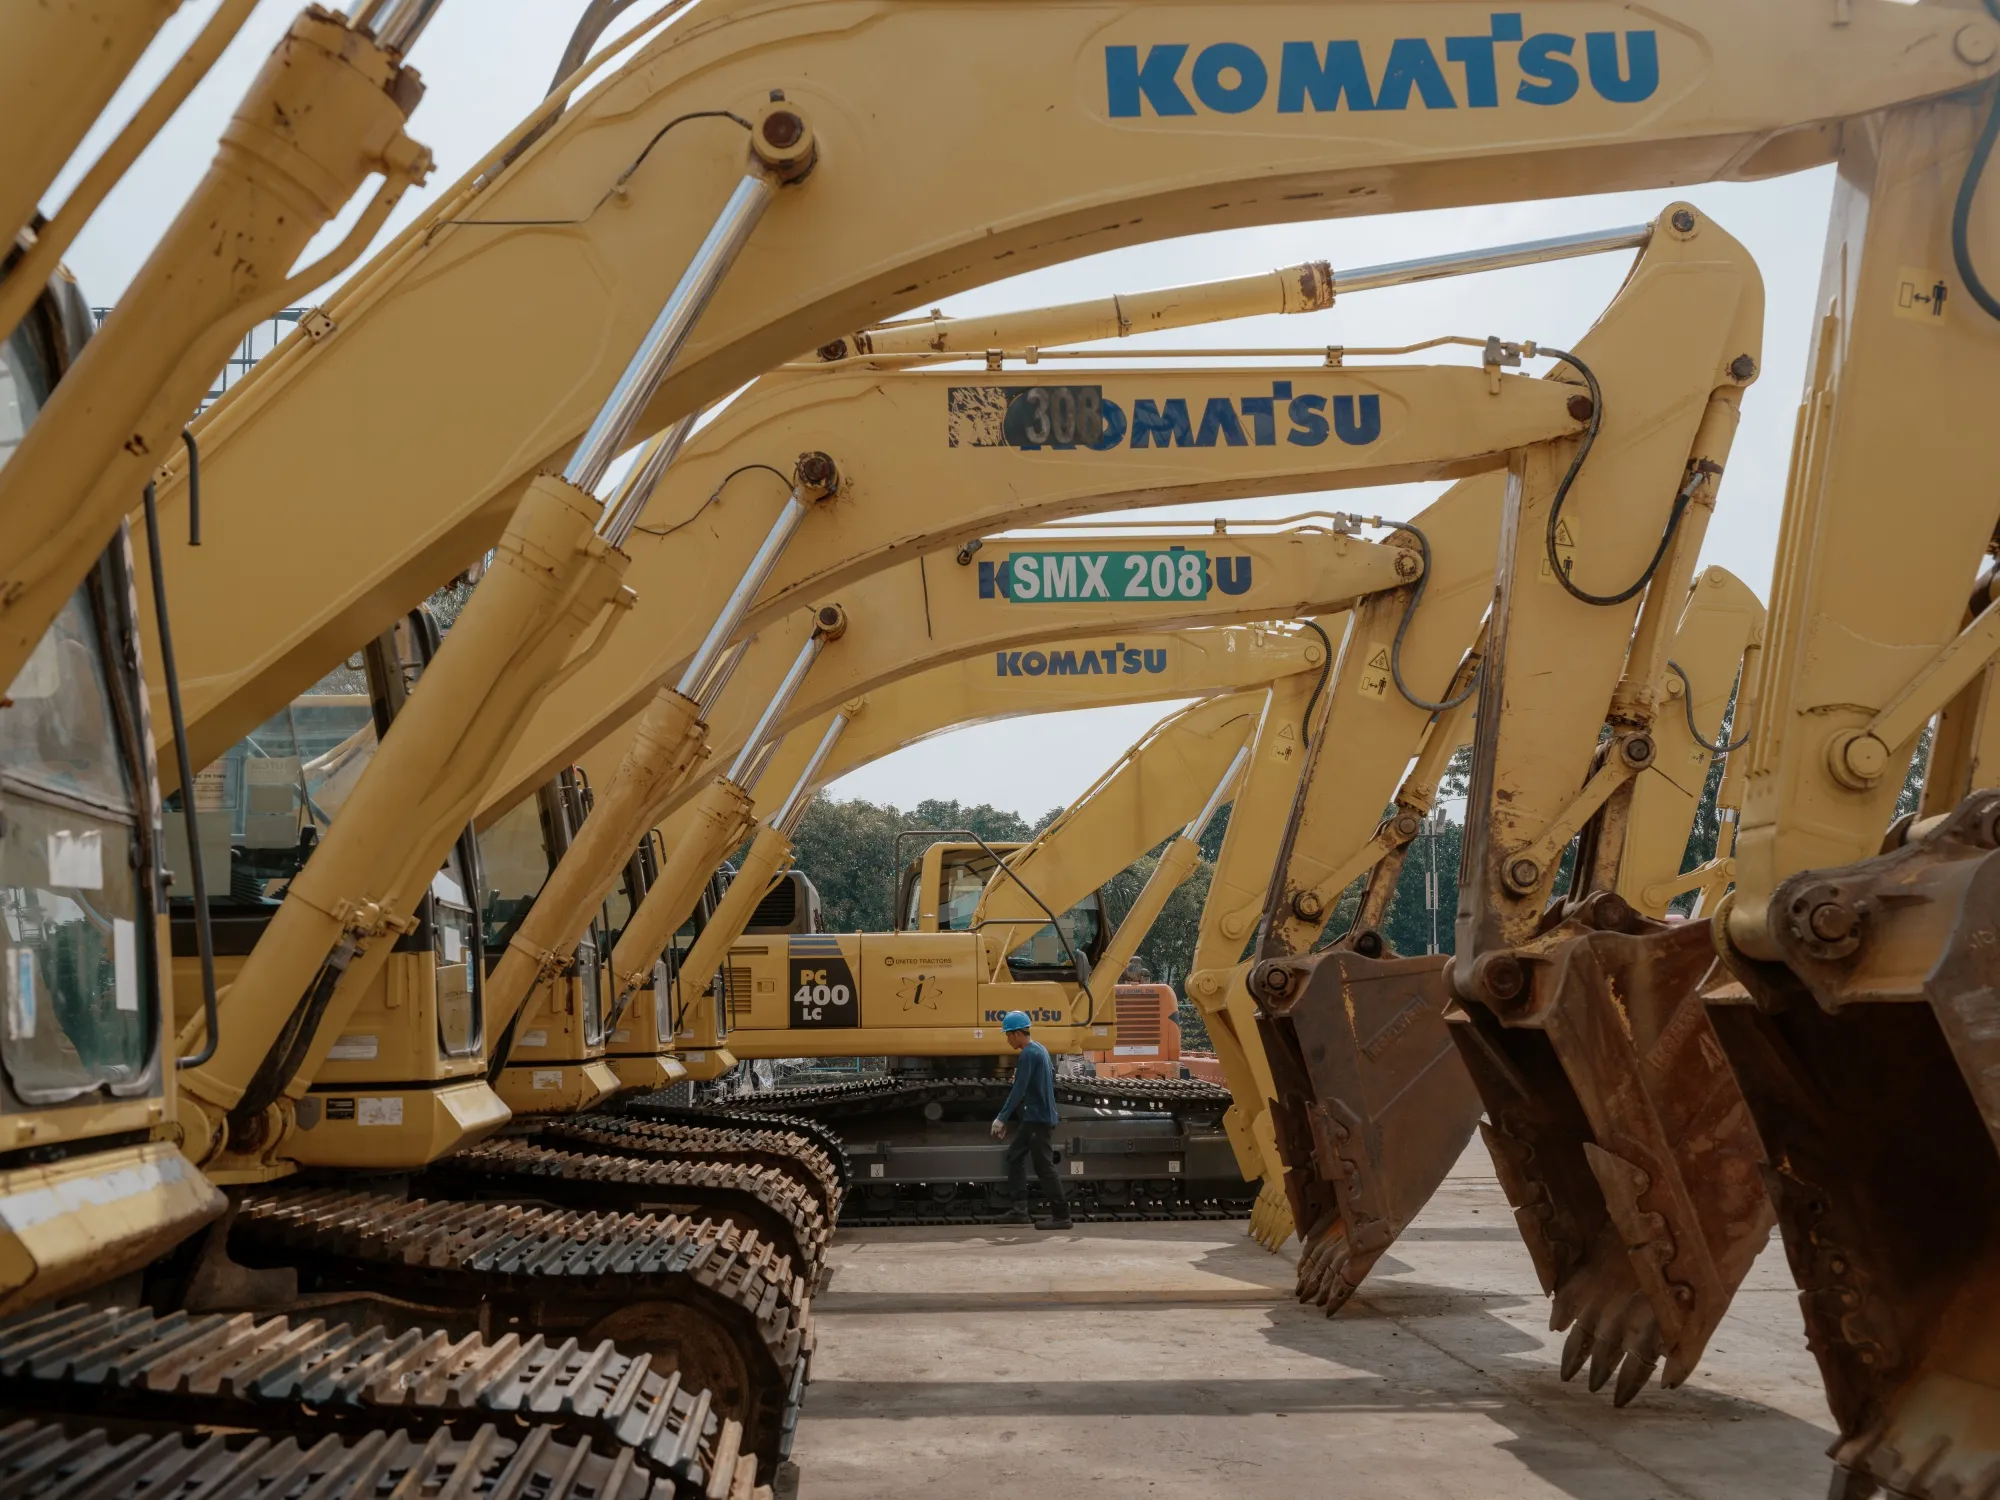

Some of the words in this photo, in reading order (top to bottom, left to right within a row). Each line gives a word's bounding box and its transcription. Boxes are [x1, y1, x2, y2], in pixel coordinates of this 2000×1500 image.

[1105, 13, 1659, 117] KOMATSU
[1020, 381, 1381, 451] OMATSU
[1026, 387, 1101, 443] 308
[1013, 556, 1110, 599] SMX
[1124, 554, 1202, 597] 208
[997, 643, 1166, 676] KOMATSU
[801, 970, 826, 985] PC
[794, 985, 849, 1005] 400
[803, 1008, 821, 1020] LC
[985, 1007, 1061, 1021] KOATSU
